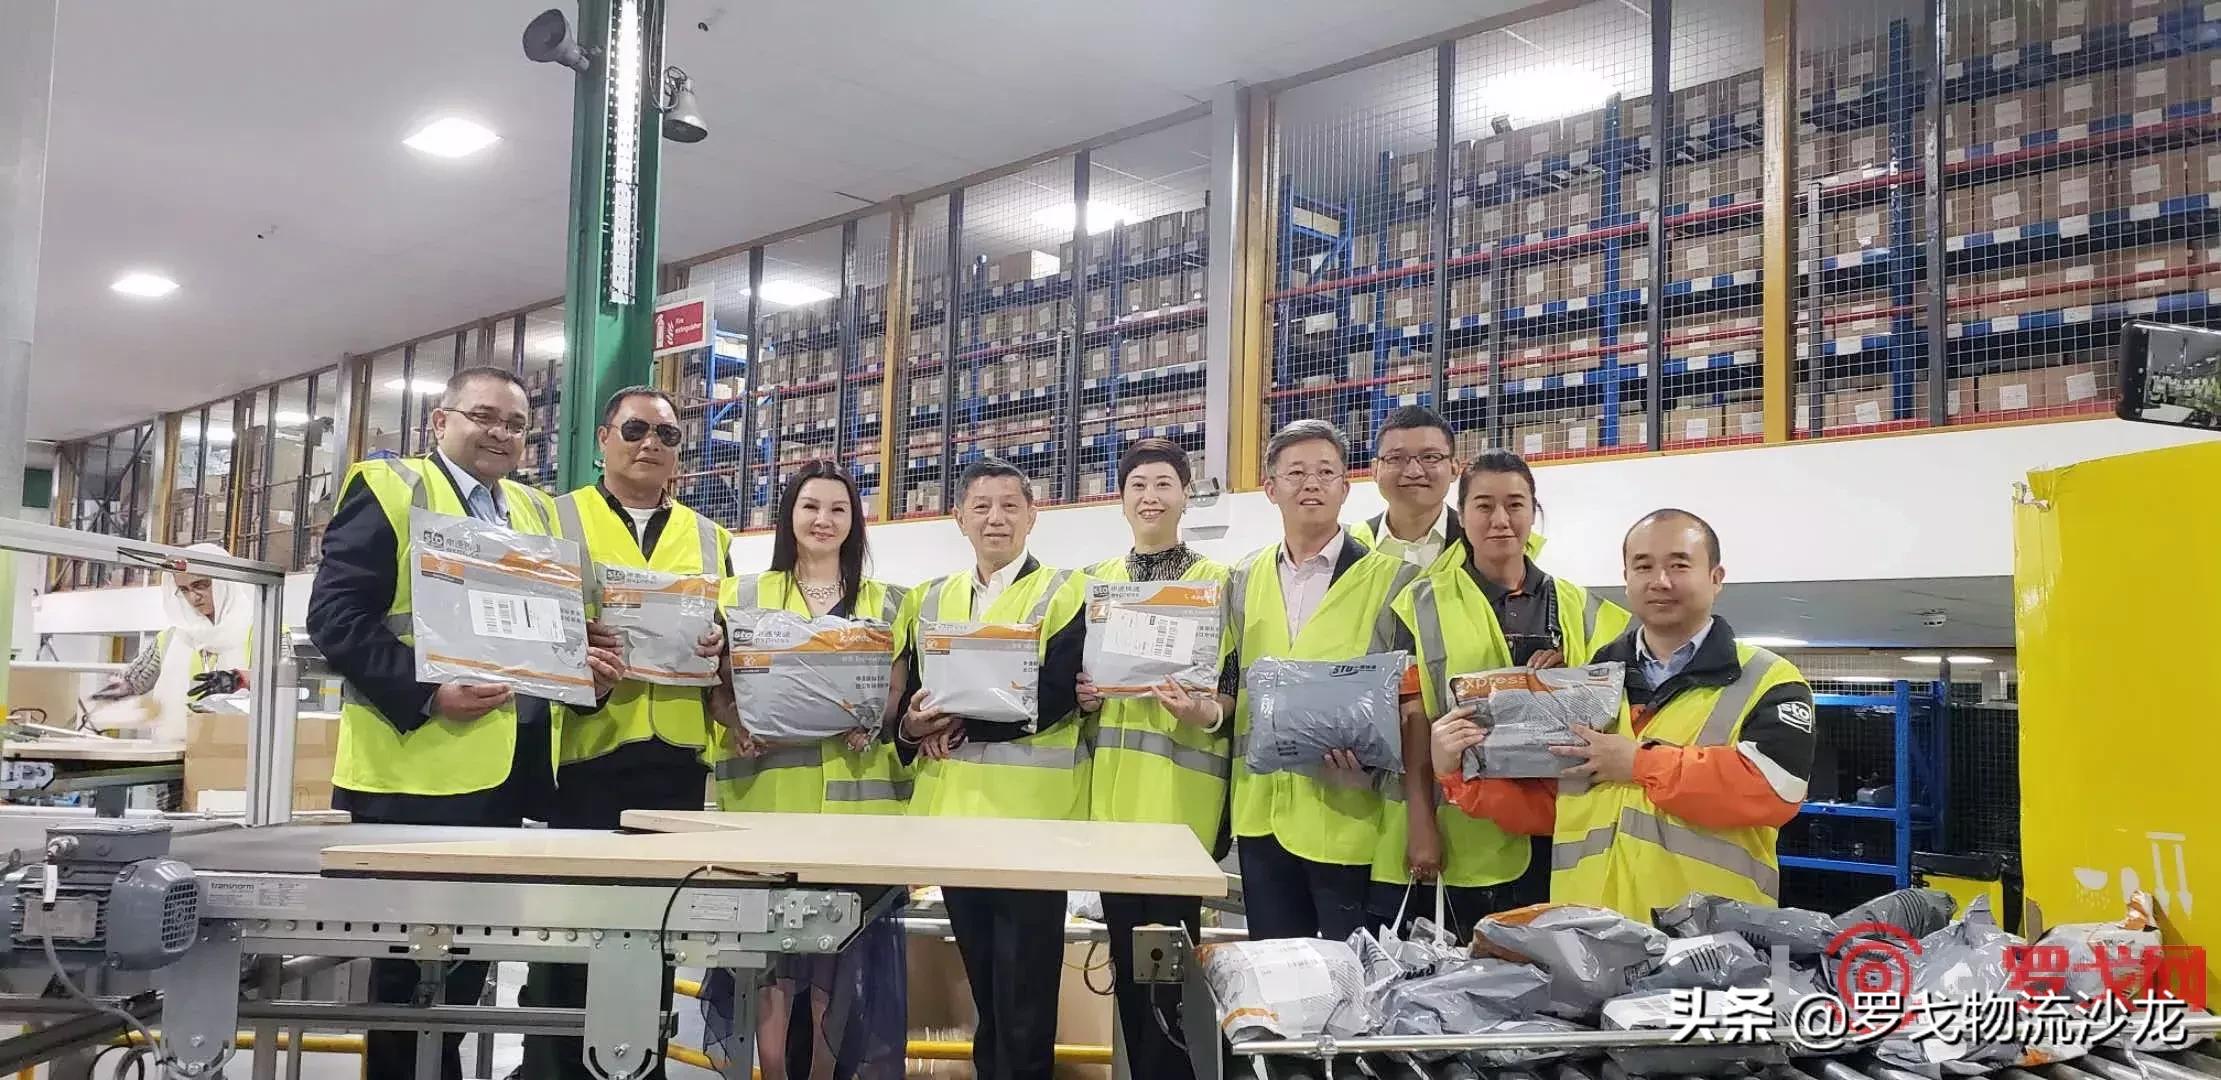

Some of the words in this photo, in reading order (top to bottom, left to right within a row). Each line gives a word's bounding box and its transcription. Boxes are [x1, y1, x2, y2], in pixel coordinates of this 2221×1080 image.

[674, 322, 702, 333] extinguisher
[735, 630, 754, 640] sto
[1780, 703, 1810, 720] sto
[211, 882, 255, 891] transnorm
